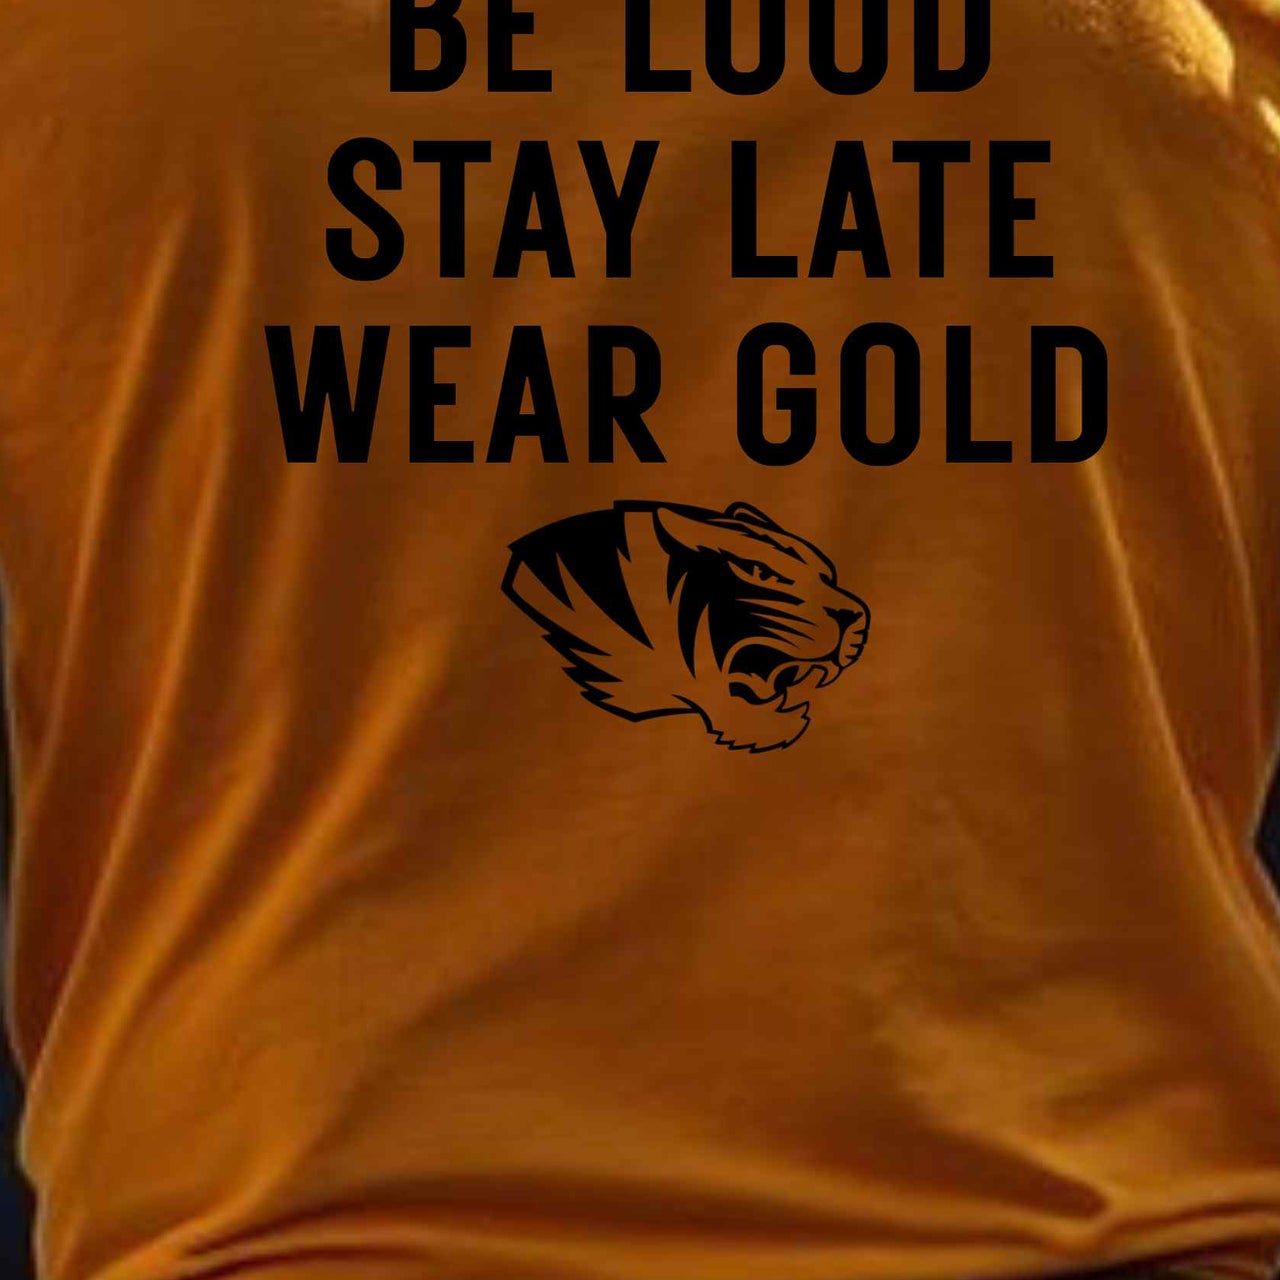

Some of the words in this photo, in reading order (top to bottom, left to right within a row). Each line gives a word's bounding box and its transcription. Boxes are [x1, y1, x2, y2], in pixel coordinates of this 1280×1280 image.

[325, 136, 661, 282] STAY
[730, 139, 1054, 279] LATE
[263, 324, 668, 464] WEAR
[736, 321, 1109, 467] GOLD
